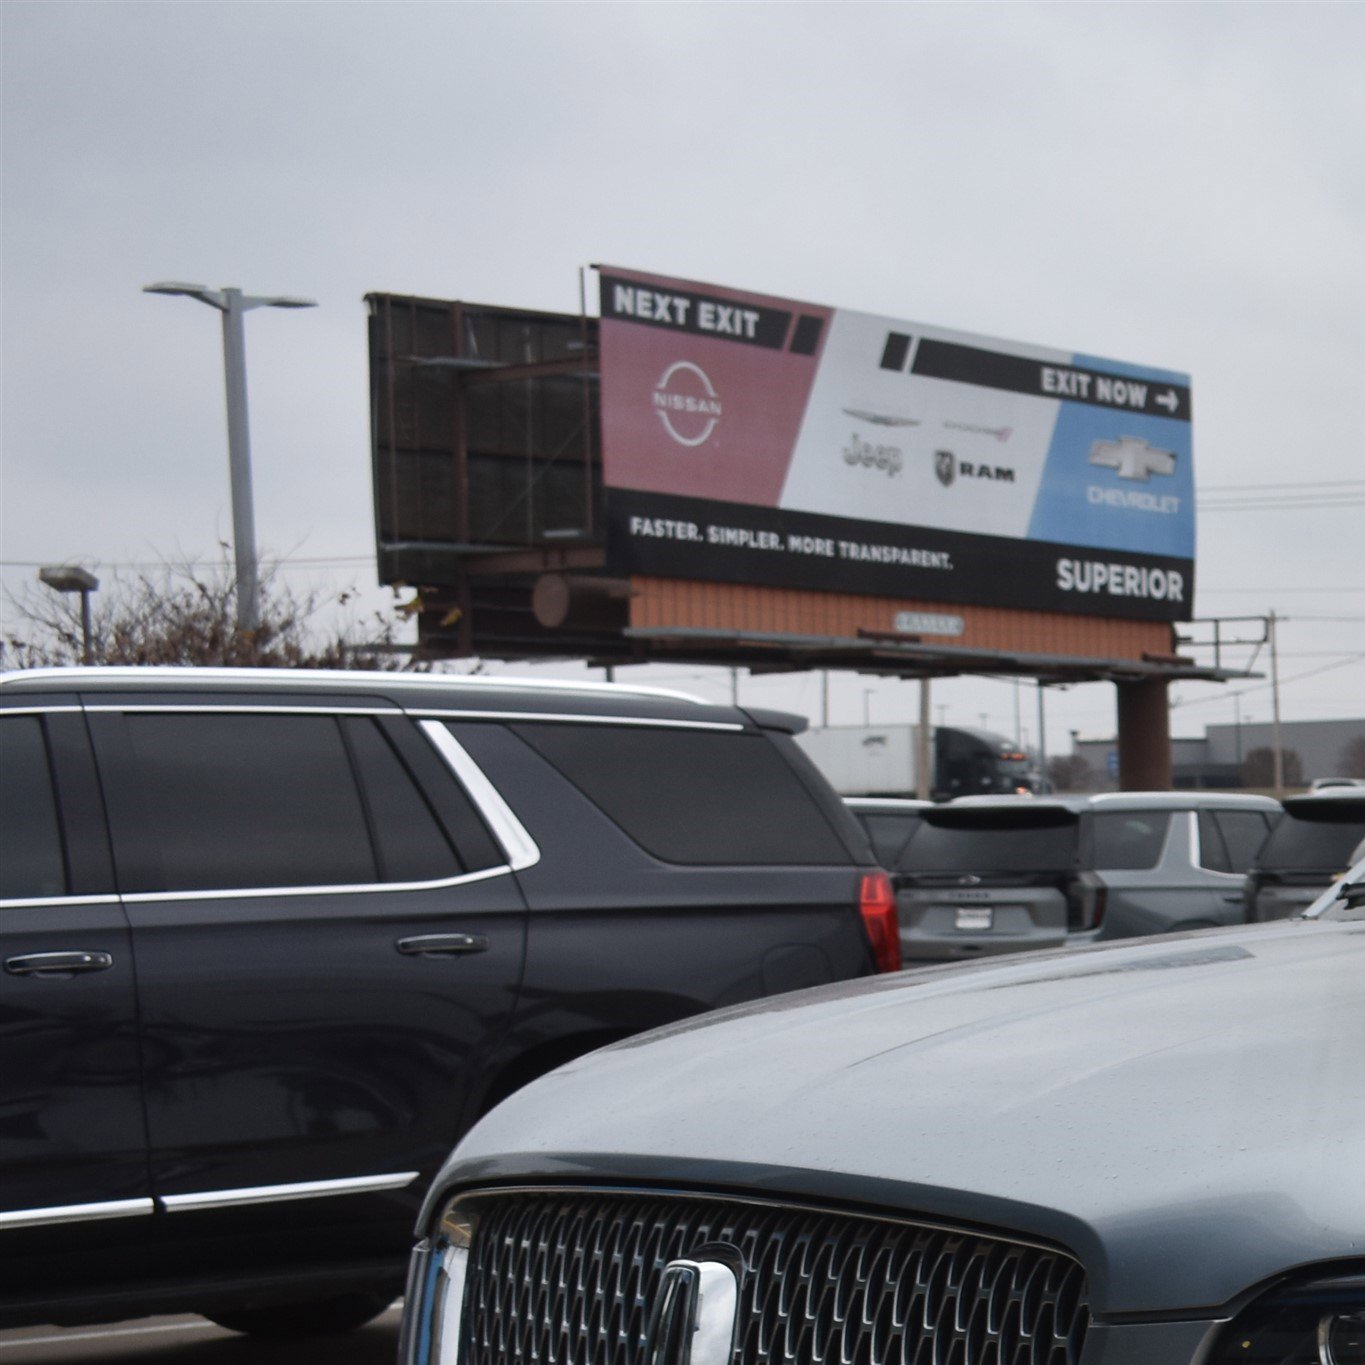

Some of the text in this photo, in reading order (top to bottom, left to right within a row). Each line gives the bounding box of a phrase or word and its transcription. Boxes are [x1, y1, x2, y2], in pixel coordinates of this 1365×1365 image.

[613, 285, 760, 338] NEXT EXIT
[653, 391, 722, 415] NISSAN
[1041, 367, 1148, 408] EXIT NOW
[843, 433, 903, 477] Jeep
[960, 462, 1016, 482] RAM
[629, 516, 953, 570] FASTER. SIMPLER. MORE TRANSPARENT.
[1056, 559, 1184, 601] SUPERIOR
